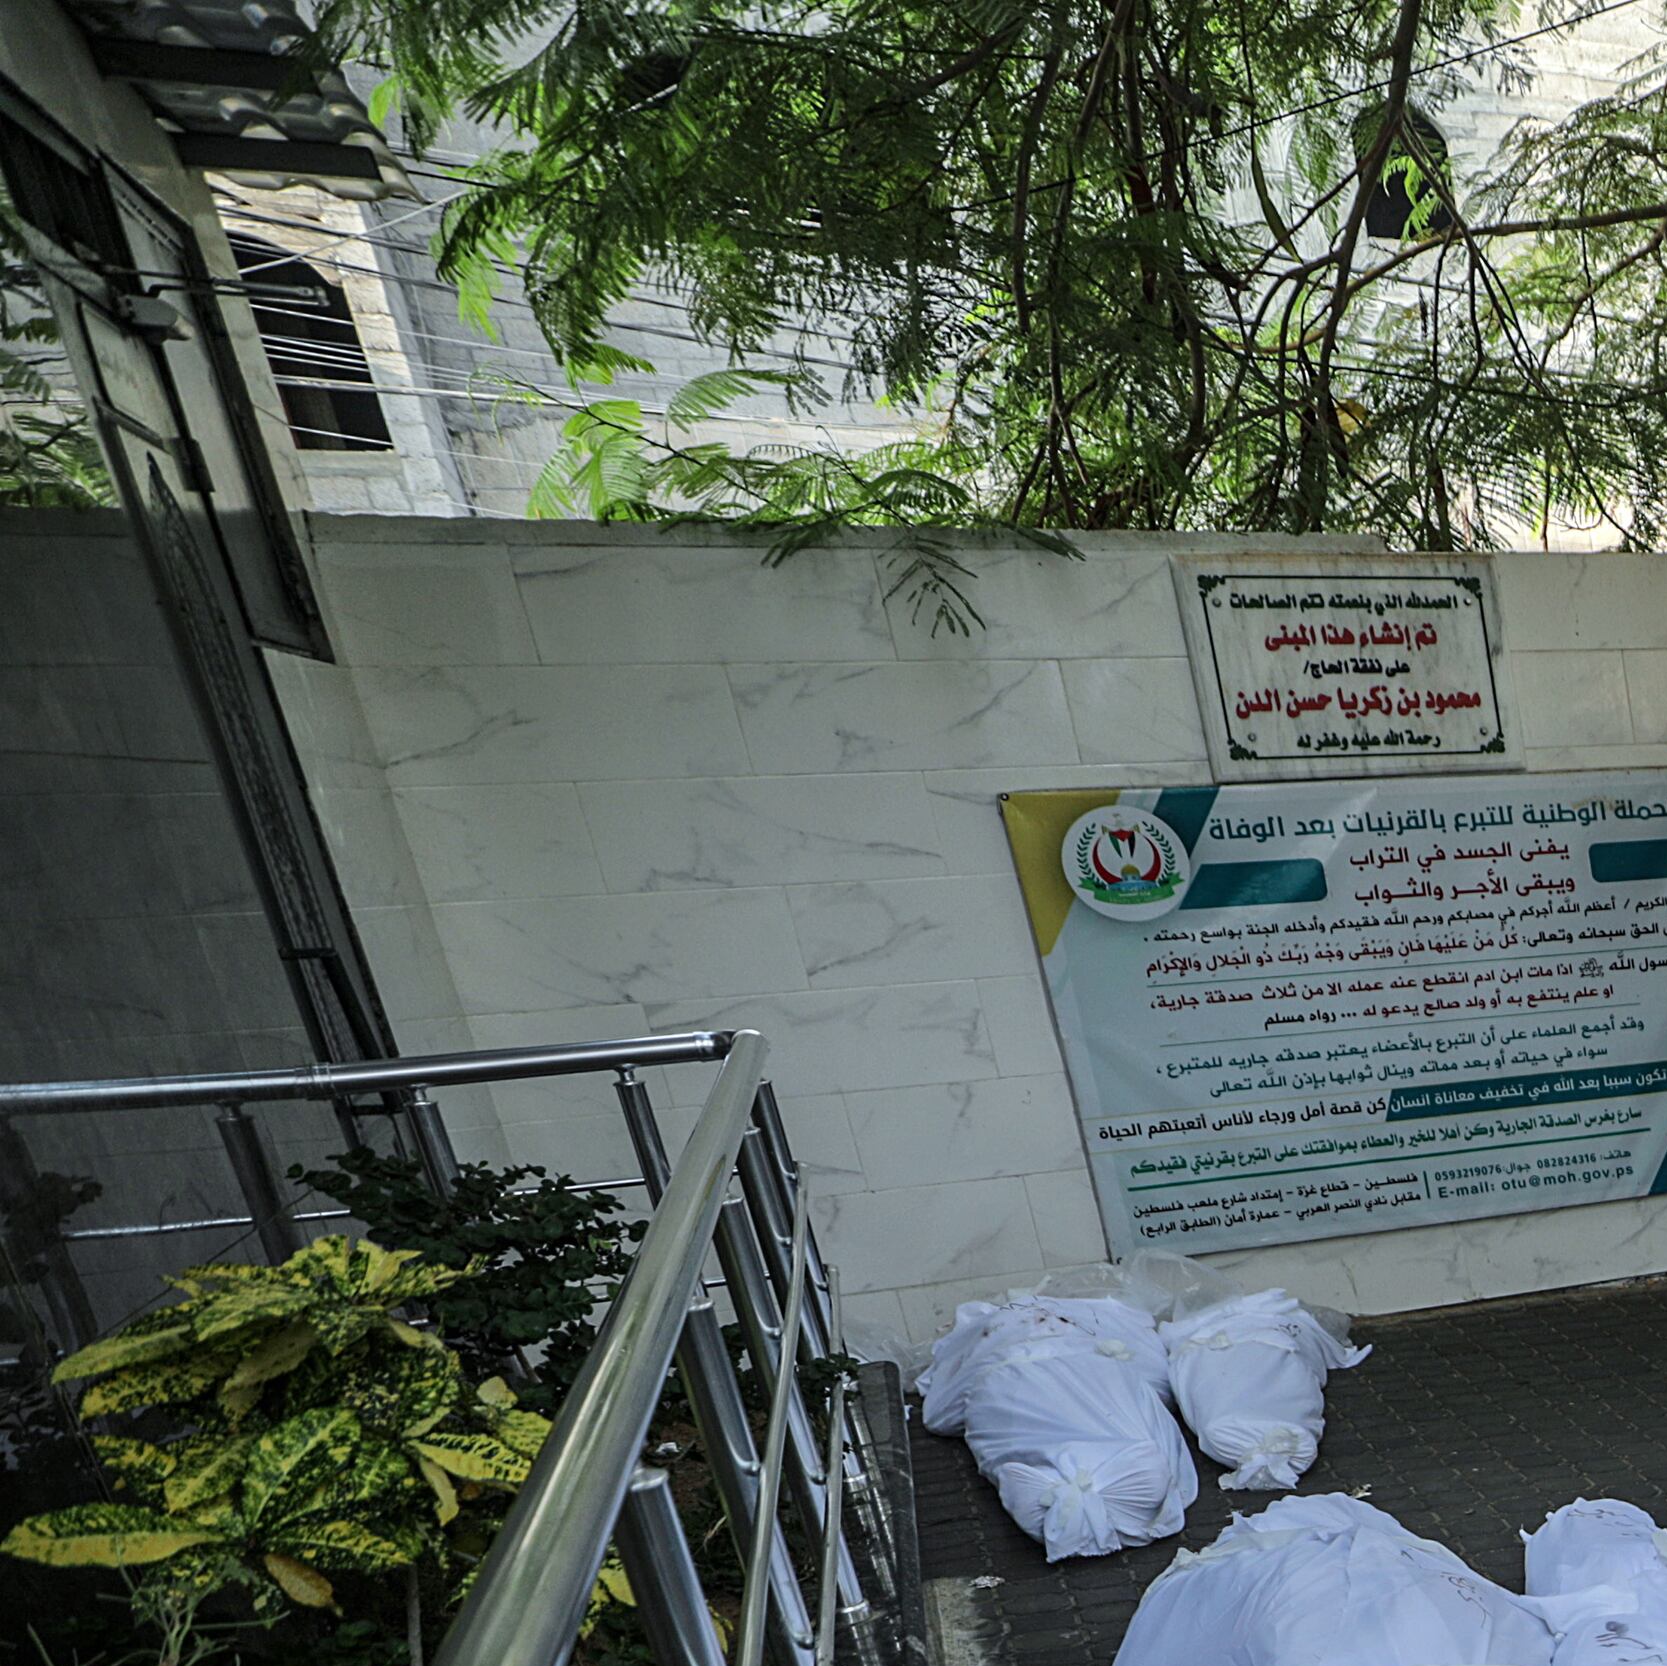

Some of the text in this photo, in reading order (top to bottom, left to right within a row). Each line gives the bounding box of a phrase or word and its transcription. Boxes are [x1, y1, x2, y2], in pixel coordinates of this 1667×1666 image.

[1229, 592, 1298, 610] الصالحات
[1299, 594, 1325, 613] تتم
[1329, 592, 1372, 614] بنعمته
[1374, 592, 1403, 615] الذي
[1265, 622, 1437, 652] تم إنشاء هذا المبنى
[1351, 659, 1383, 675] نفقة
[1386, 659, 1410, 678] على
[1287, 688, 1333, 718] حسن
[1337, 685, 1393, 719] زكريا
[1398, 687, 1421, 718] بن
[1425, 689, 1481, 716] محمود
[1297, 733, 1312, 749] له
[1314, 732, 1348, 751] وغفر
[1351, 732, 1381, 750] عليه
[1384, 728, 1405, 747] الله
[1343, 808, 1447, 836] بالقرنيات
[1454, 805, 1513, 832] للتبرع
[1522, 801, 1606, 828] الوطنية
[1209, 816, 1285, 843] الوفاة
[1294, 818, 1336, 839] بعد
[1349, 838, 1570, 873] يفنى الجسد في التراب
[1515, 873, 1576, 897] ويبقى
[1519, 900, 1553, 920] أجركم
[1584, 895, 1616, 916] أعظم
[1635, 896, 1667, 913] الكريم
[1284, 914, 1326, 933] وأدخله
[1329, 915, 1380, 935] فقيدكم
[1412, 914, 1444, 928] ورحم
[1447, 909, 1494, 926] مصابكم
[1498, 906, 1515, 926] في
[1153, 929, 1195, 942] رحمته
[1200, 927, 1242, 943] بواسع
[1246, 922, 1279, 938] الجنة
[1578, 927, 1626, 942] سبحانه
[1630, 922, 1659, 939] الحق
[1499, 967, 1523, 985] ابن
[1527, 965, 1553, 979] مات
[1556, 963, 1573, 976] اذا
[1347, 980, 1384, 994] عمله
[1389, 976, 1417, 989] عنه
[1422, 972, 1469, 992] انقطع
[1473, 970, 1495, 988] ادم
[1261, 981, 1297, 1001] ثلاث
[1302, 984, 1324, 1000] من
[1327, 982, 1342, 996] الا
[1205, 991, 1254, 1006] صدقة
[1264, 984, 1614, 1031] او علم ينتفع به أو ولد صالح يدعو له رواه مسلم
[1166, 1014, 1645, 1079] وقد أجمع العلماء على أن التبرع بالأعضاء يعتبر صدقه جاريه للمتبرع
[1577, 1046, 1608, 1058] سواء
[1419, 1060, 1458, 1073] مماته
[1463, 1057, 1490, 1071] بعد
[1494, 1048, 1505, 1070] أو
[1510, 1051, 1549, 1066] حياته
[1553, 1047, 1573, 1068] في
[1292, 1072, 1326, 1089] بإذن
[1329, 1063, 1373, 1086] ثوابها
[1376, 1063, 1415, 1081] وينال
[1635, 1068, 1667, 1087] تكون
[1209, 1077, 1252, 1098] تعالى
[1527, 1081, 1549, 1099] في
[1553, 1076, 1575, 1092] الله
[1578, 1079, 1600, 1091] بعد
[1602, 1074, 1632, 1089] سببا
[1434, 1091, 1475, 1107] معاناة
[1478, 1083, 1524, 1101] تخفيف
[1300, 1101, 1325, 1122] أمل
[1329, 1101, 1362, 1115] قصة
[1367, 1097, 1386, 1115] كن
[1390, 1093, 1430, 1113] انسان
[1212, 1110, 1254, 1131] لأناس
[1258, 1108, 1296, 1124] ورجاء
[1539, 1112, 1581, 1129] الصدقة
[1584, 1108, 1615, 1128] بغرس
[1616, 1107, 1642, 1121] سارع
[1099, 1122, 1142, 1141] الحياة
[1148, 1114, 1207, 1139] أتعبتهم
[1463, 1123, 1494, 1141] وكن
[1497, 1119, 1538, 1134] الجارية
[1302, 1139, 1358, 1155] بموافقتك
[1361, 1134, 1405, 1149] والعطاء
[1408, 1128, 1436, 1148] للخير
[1189, 1150, 1235, 1175] بقرنيتي
[1238, 1148, 1271, 1167] التبرع
[1274, 1145, 1298, 1162] على
[1536, 1153, 1597, 1169] 082824316
[1130, 1155, 1188, 1179] فقيدكم
[1250, 1189, 1283, 1203] إمتداد
[1297, 1184, 1317, 1197] غزة
[1320, 1181, 1349, 1197] قطاع
[1438, 1181, 1495, 1198] E-mail:
[1187, 1199, 1219, 1211] ملعب
[1221, 1192, 1247, 1210] شارع
[1333, 1199, 1361, 1213] النصر
[1364, 1195, 1388, 1213] نادي
[1390, 1191, 1421, 1207] مقابل
[1133, 1199, 1184, 1219] فلسطين
[1224, 1208, 1247, 1227] أمان
[1250, 1209, 1280, 1221] عمارة
[1295, 1202, 1330, 1220] العربي
